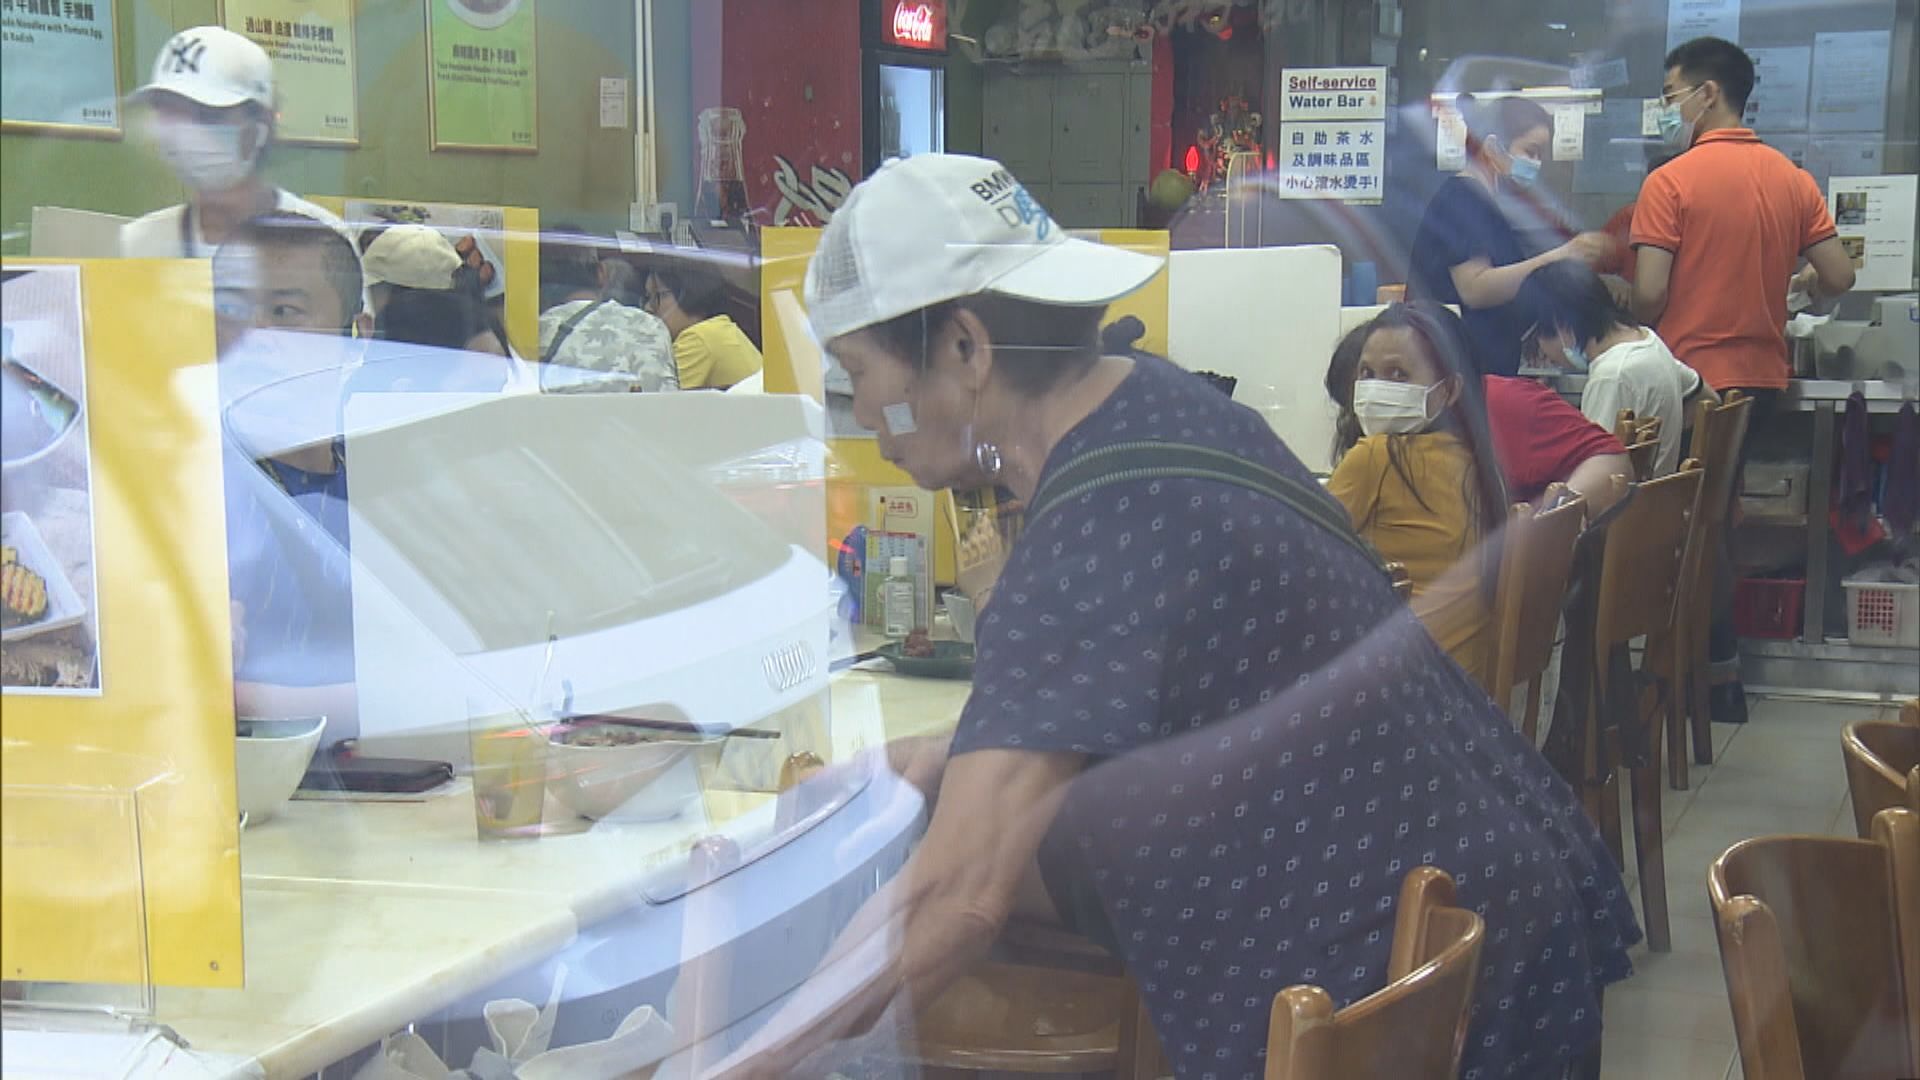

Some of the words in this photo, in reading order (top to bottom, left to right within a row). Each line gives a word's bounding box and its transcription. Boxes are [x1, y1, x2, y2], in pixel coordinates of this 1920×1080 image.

[1289, 76, 1377, 89] Self-service
[1289, 95, 1333, 109] Water
[1337, 94, 1365, 107] Bar
[1292, 131, 1374, 145] 自助茶水
[1292, 152, 1370, 167] 及調味品區
